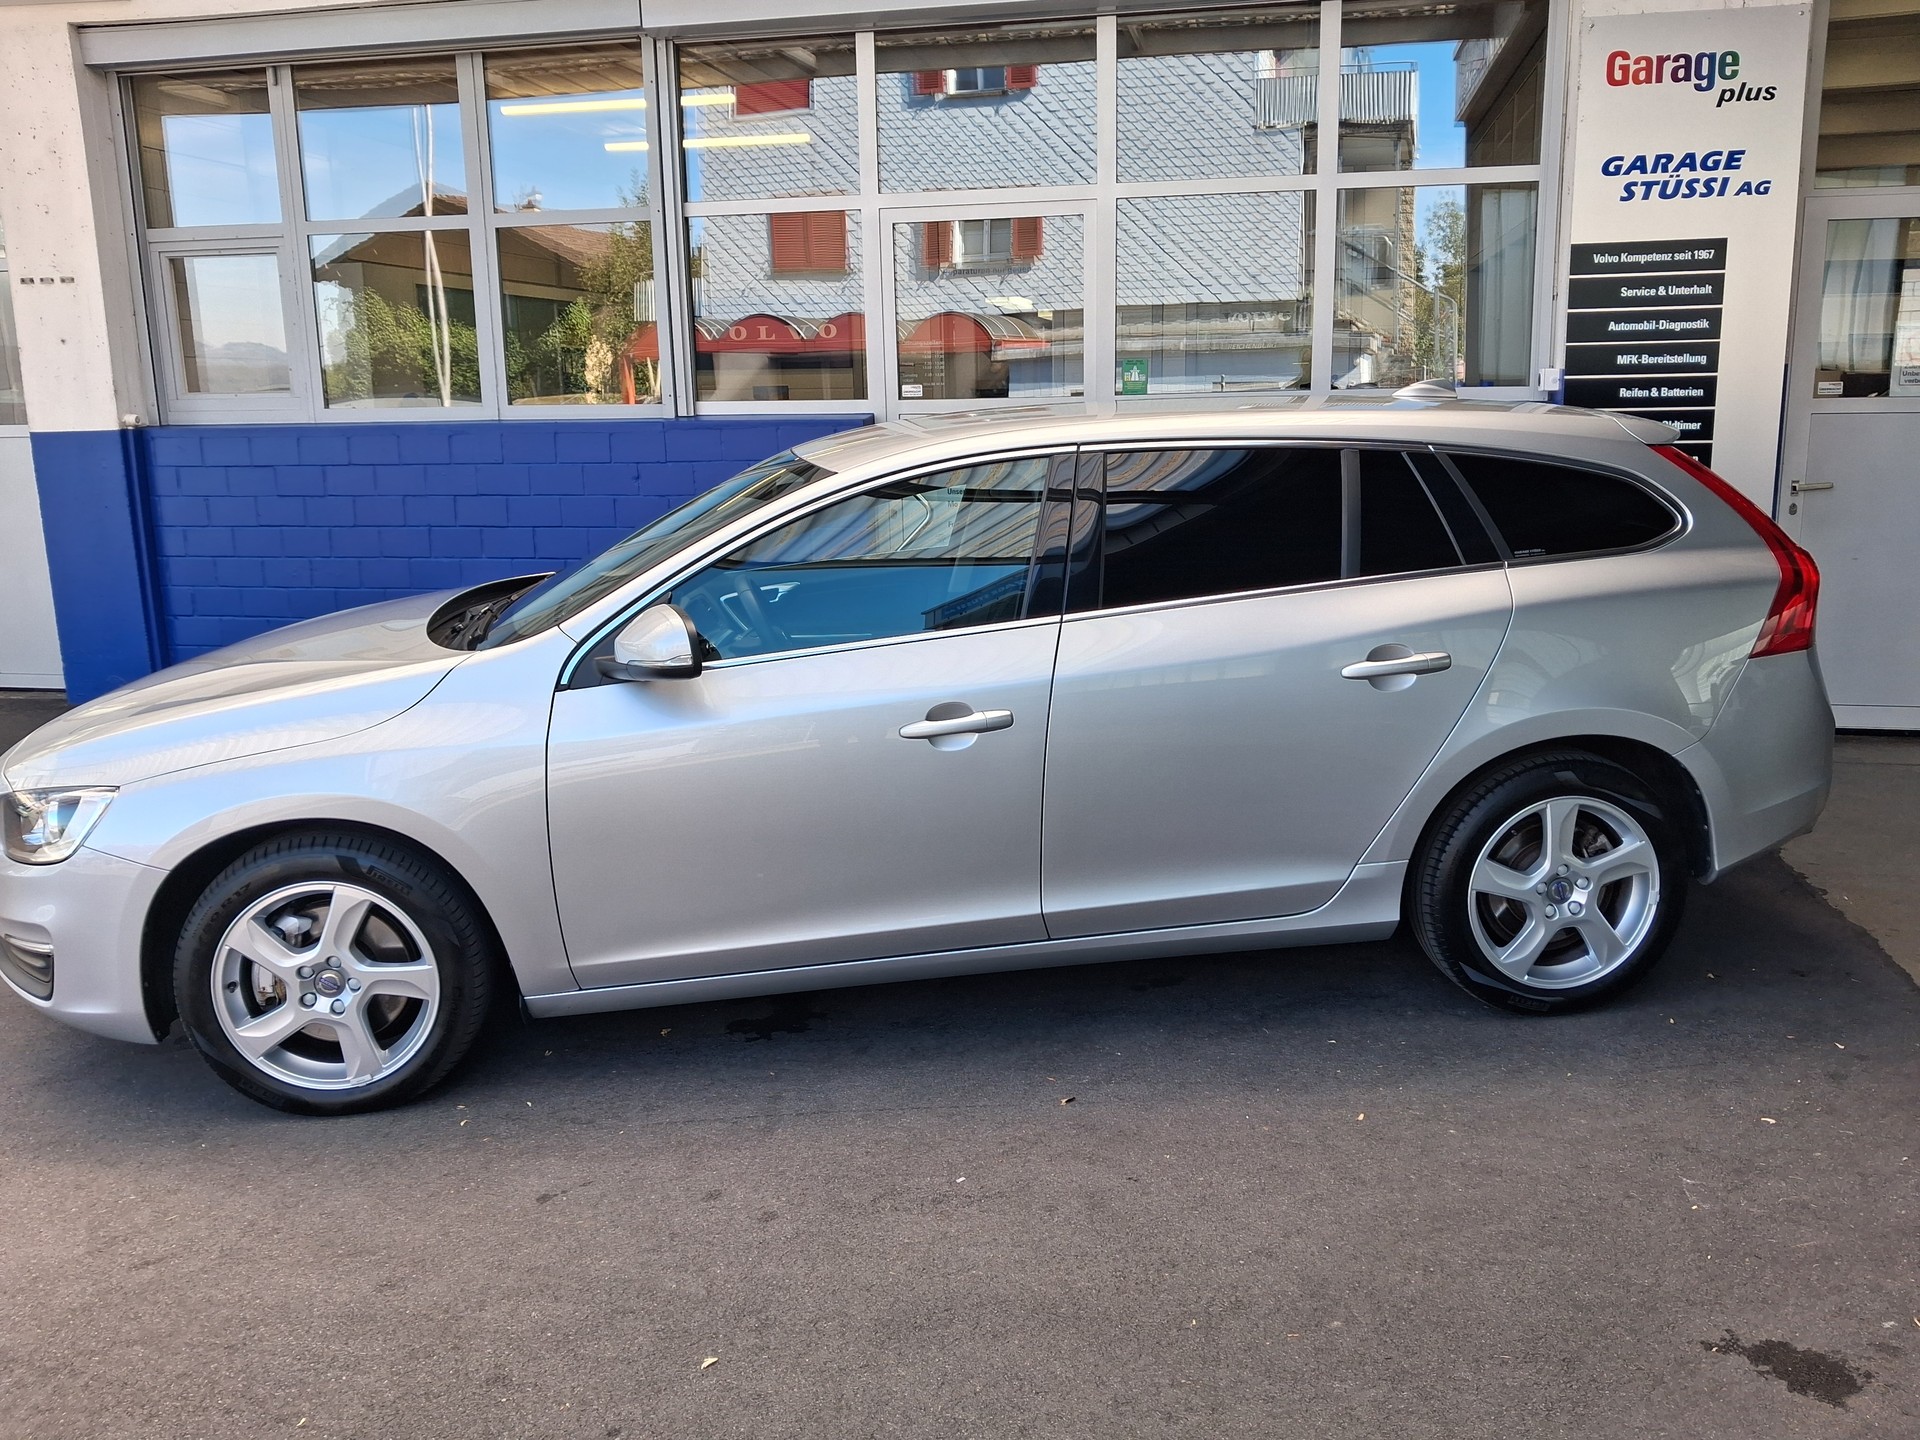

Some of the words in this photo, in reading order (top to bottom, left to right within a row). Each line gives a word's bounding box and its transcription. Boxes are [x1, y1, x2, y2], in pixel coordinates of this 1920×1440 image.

[1606, 50, 1740, 92] Garage
[1715, 82, 1778, 108] plus
[1601, 149, 1747, 177] GARAGE
[1619, 174, 1731, 202] STÜSSI
[1733, 180, 1773, 196] AG
[1593, 252, 1619, 264] Volvo
[1620, 251, 1673, 264] Kompetenz
[1673, 250, 1692, 261] seit
[1693, 249, 1715, 260] 1967
[1620, 286, 1656, 297] Service
[1658, 286, 1667, 296] &
[1668, 284, 1713, 296] Unterhalt
[1608, 318, 1710, 332] Automobil-Diagnostik
[1616, 353, 1707, 366] MFK-Bereitstellung
[1619, 387, 1649, 398] Reifen
[1650, 387, 1659, 397] &
[1660, 386, 1704, 397] Batterien
